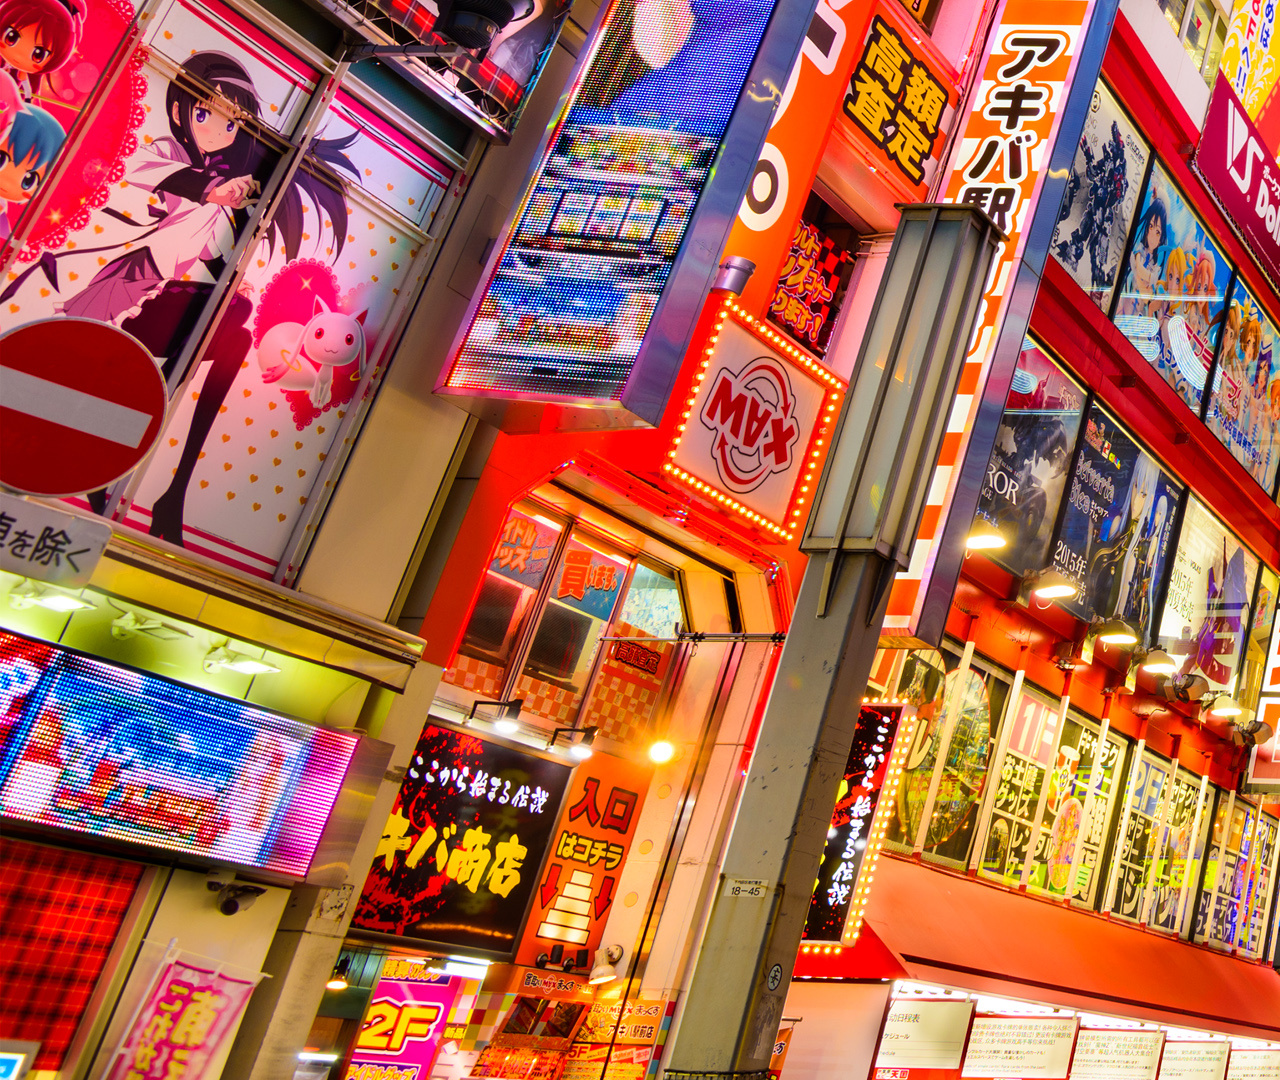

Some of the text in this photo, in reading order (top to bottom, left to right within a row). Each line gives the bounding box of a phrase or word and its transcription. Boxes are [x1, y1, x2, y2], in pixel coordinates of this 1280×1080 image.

[569, 776, 638, 836] 入口
[555, 831, 624, 871] はコチラ
[359, 1000, 441, 1052] 2F
